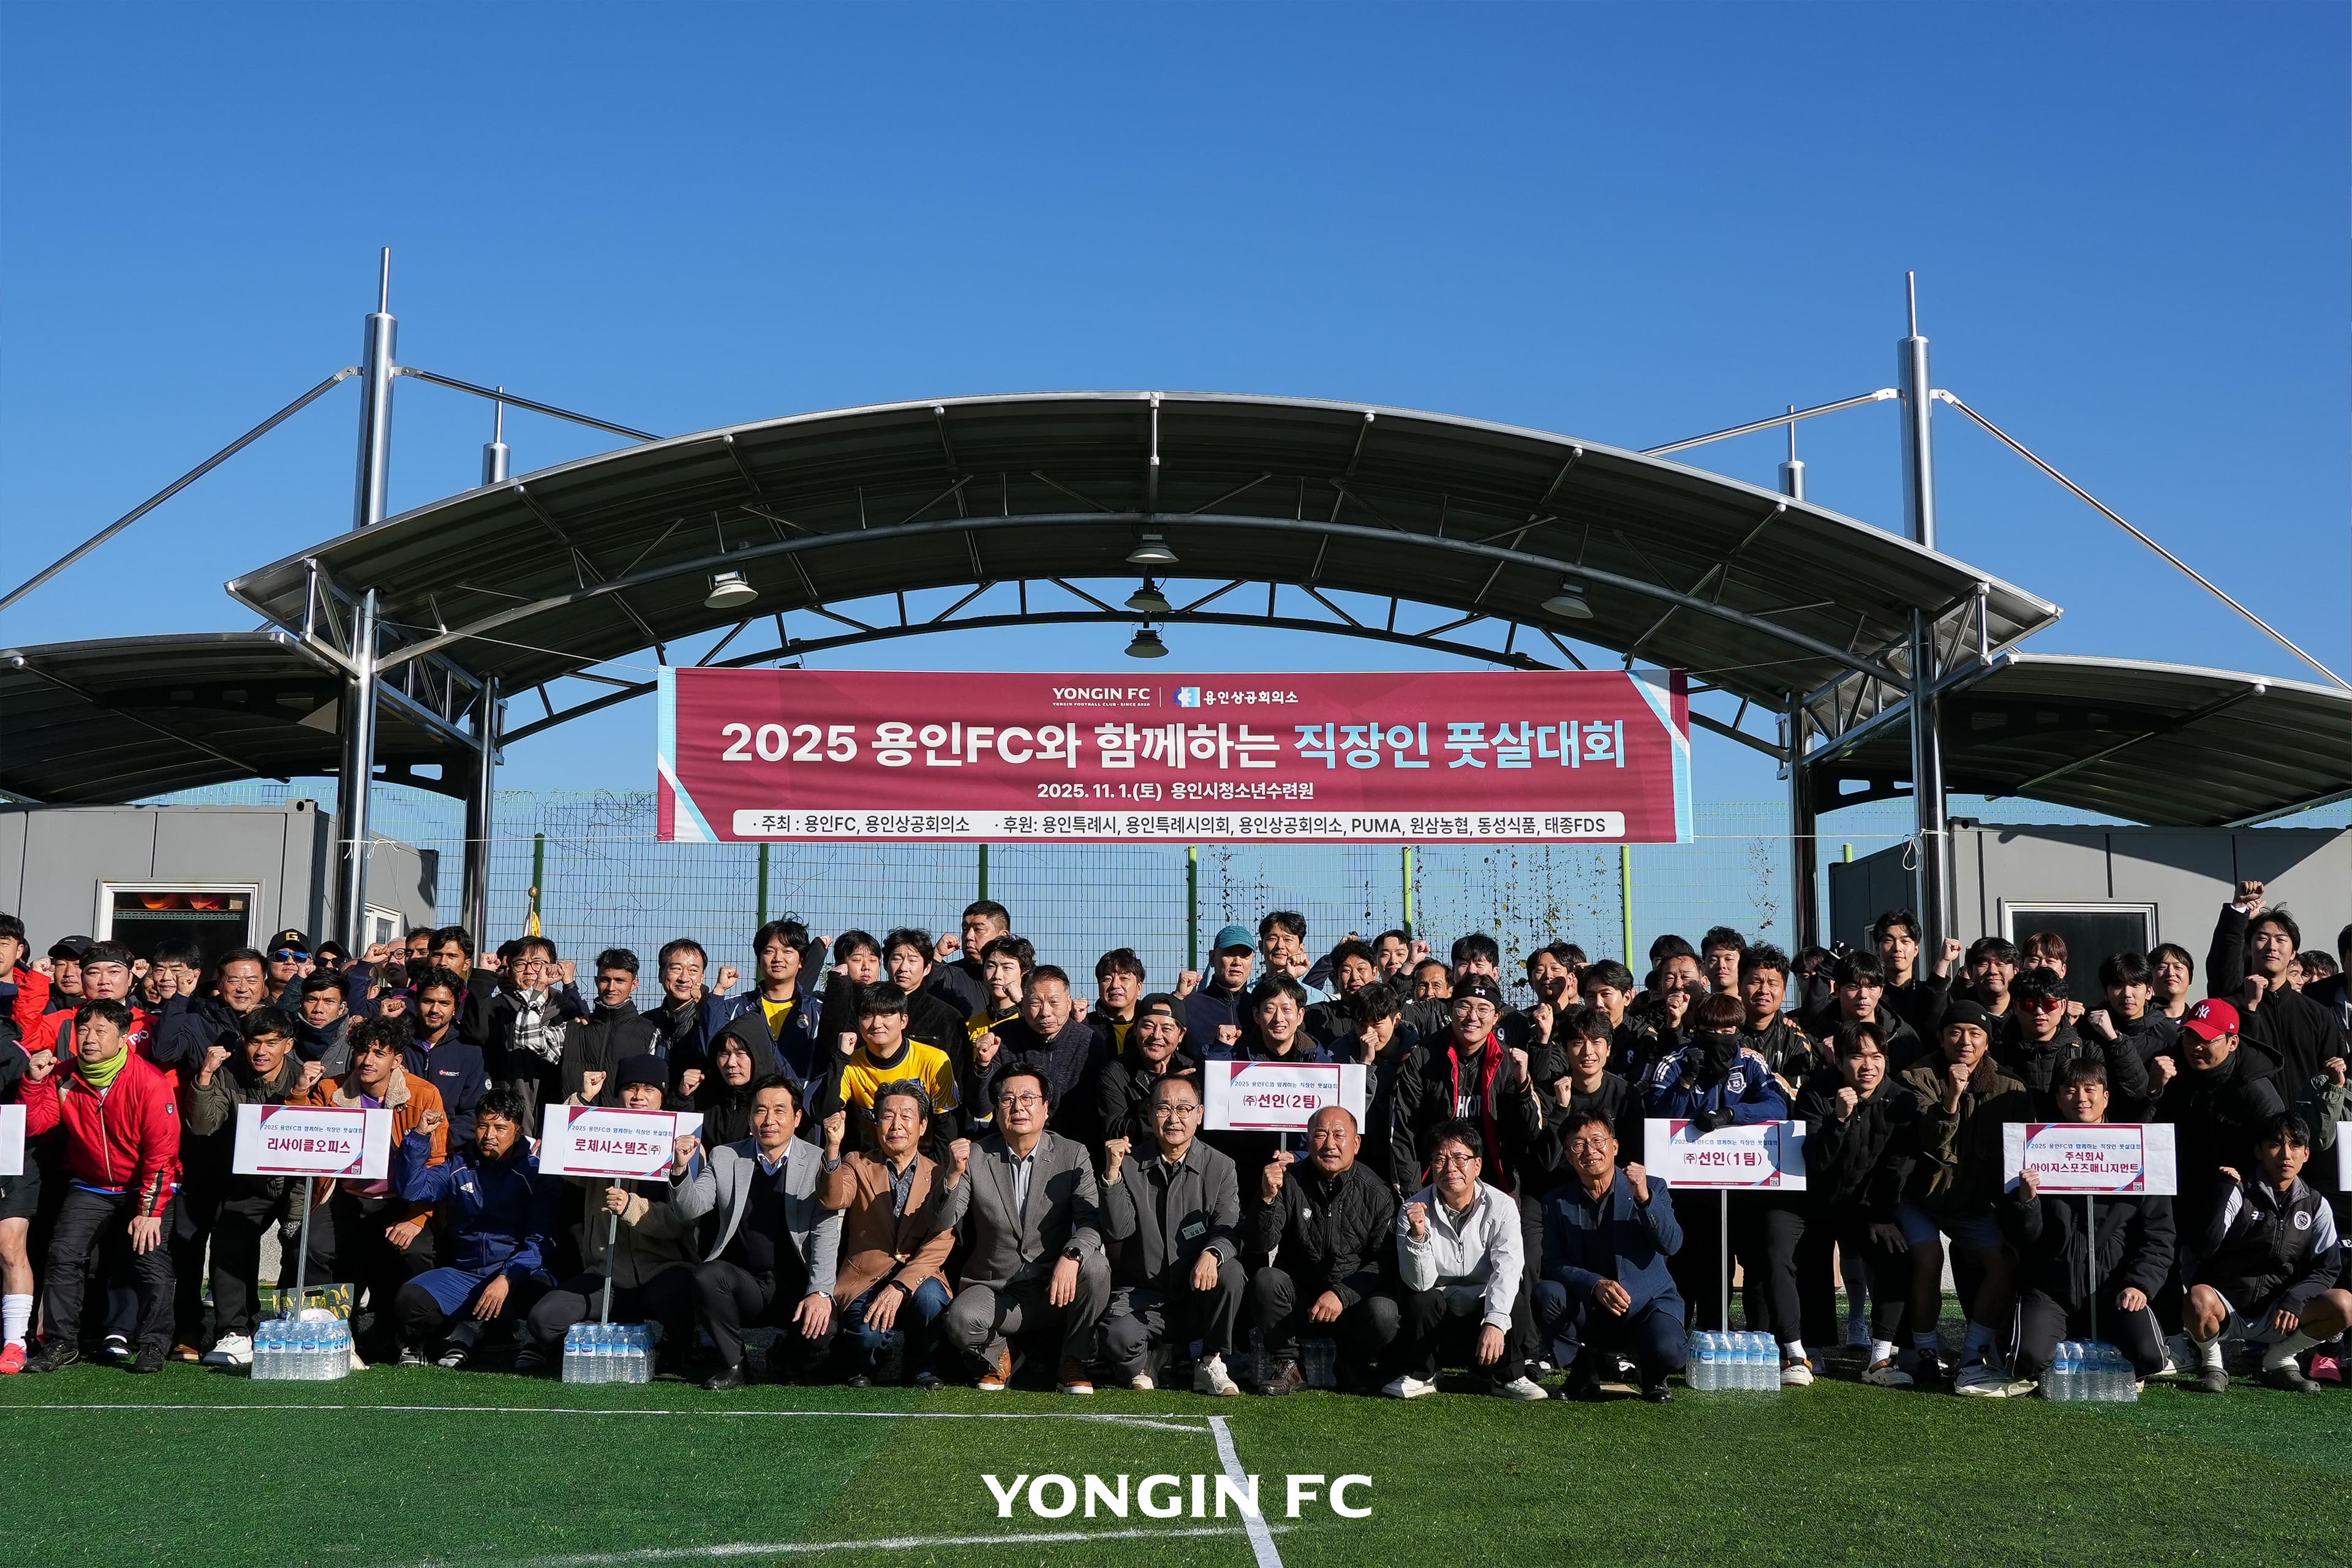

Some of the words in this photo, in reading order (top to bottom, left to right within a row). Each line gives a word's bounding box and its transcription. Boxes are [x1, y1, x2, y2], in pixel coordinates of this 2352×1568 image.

[1052, 687, 1122, 699] YONGIN
[1128, 688, 1150, 700] FC
[1203, 690, 1298, 705] 용인상공회의소
[722, 723, 858, 762] 2025
[871, 722, 1082, 769] 용인FC와
[1094, 723, 1280, 769] 함께하는
[1293, 722, 1430, 769] 직장인
[1444, 720, 1625, 769] 풋살대회
[1038, 783, 1089, 798] 2025.
[1093, 783, 1115, 798] 11.
[1170, 782, 1314, 800] 용인시청소년수련원
[804, 815, 860, 835] 용인FC,
[865, 815, 970, 834] 용인상공회의소
[1003, 816, 1037, 834] 후원:
[1042, 816, 1121, 836] 용인특례시,
[1126, 816, 1234, 836] 용인특례시의회,
[1238, 816, 1347, 837] 용인상공회의소,
[1352, 818, 1405, 837] PUMA,
[1410, 816, 1473, 837] 원삼농협,
[1477, 816, 1540, 836] 동성식품,
[1545, 816, 1605, 834] 태종FDS
[267, 1137, 350, 1153] 리사이클오피스
[2064, 1152, 2104, 1161] 주식회사
[2030, 1163, 2139, 1174] 아이지스포츠매니지먼트
